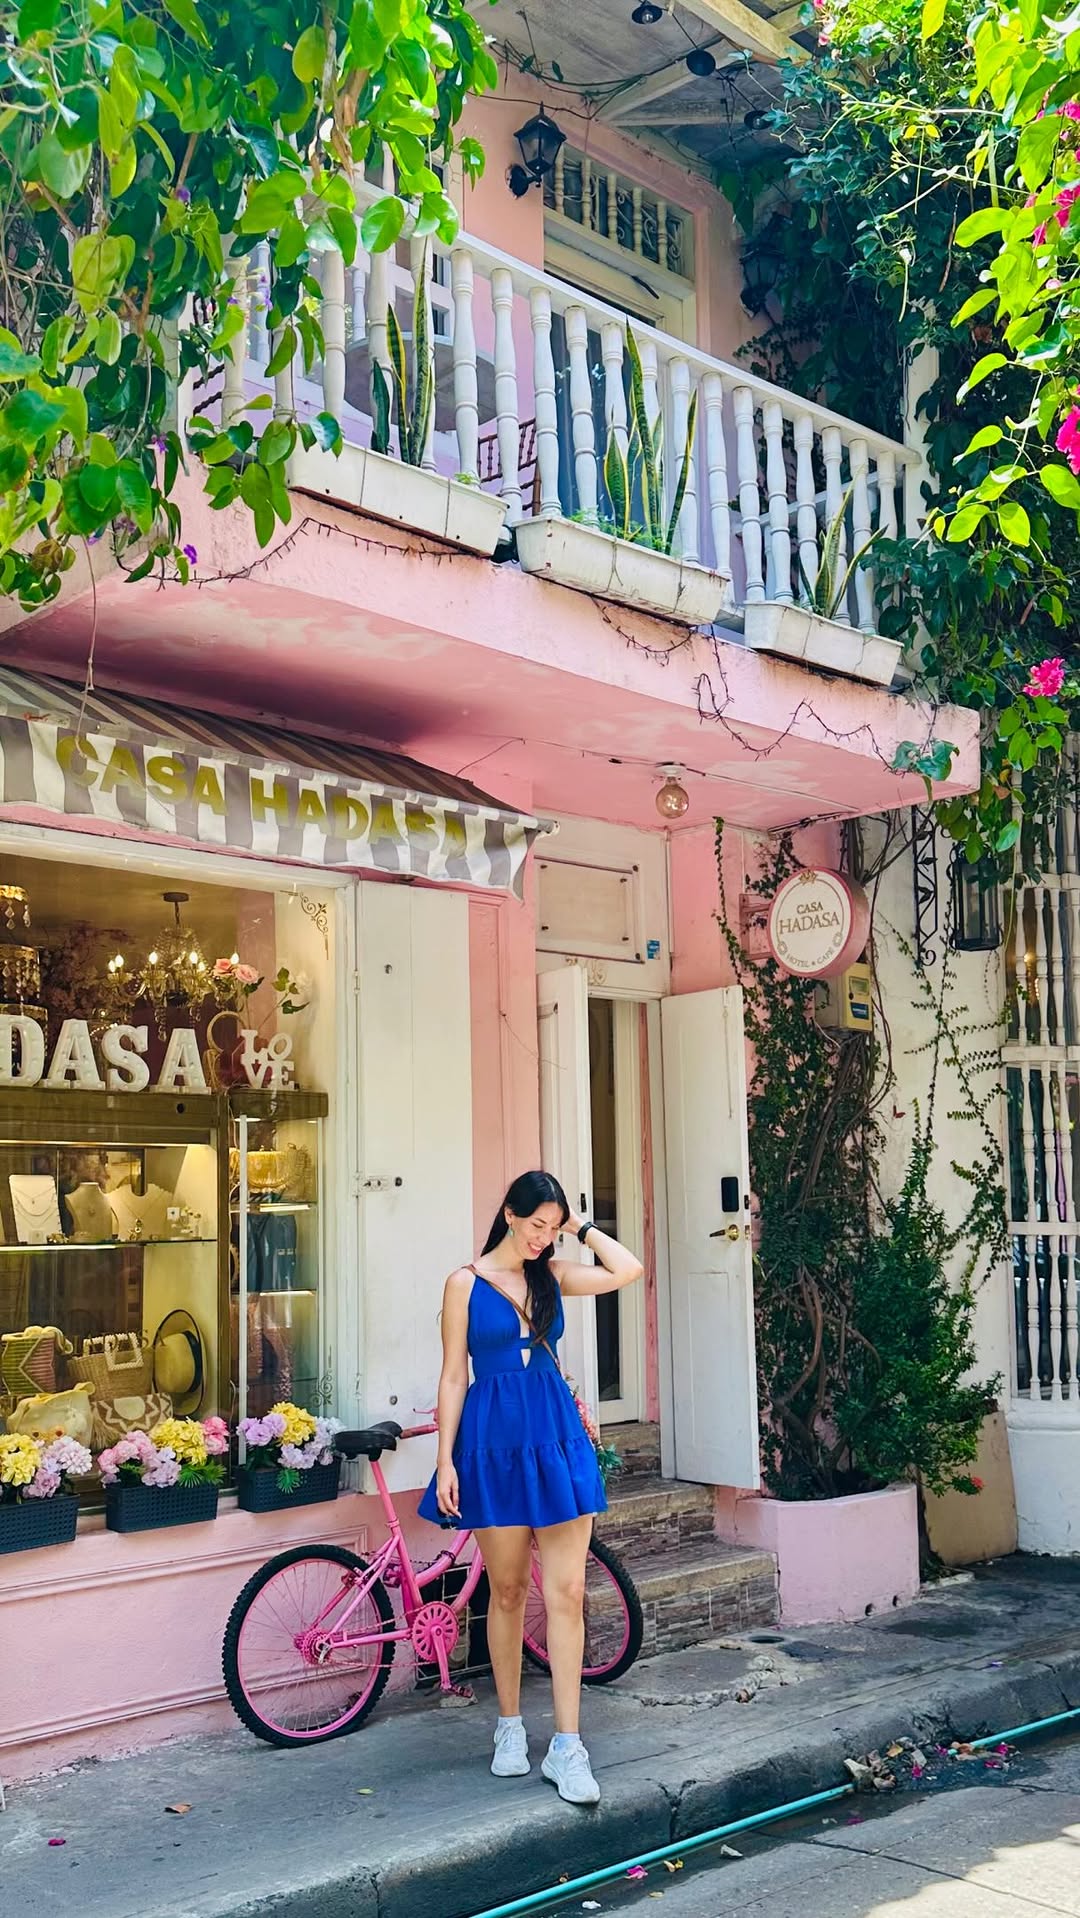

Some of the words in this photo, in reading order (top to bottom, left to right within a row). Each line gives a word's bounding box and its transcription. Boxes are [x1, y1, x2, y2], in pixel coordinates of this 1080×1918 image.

[57, 735, 229, 816] CASA
[250, 776, 469, 855] HADASA
[796, 901, 824, 915] CASA
[779, 912, 839, 934] HADASA
